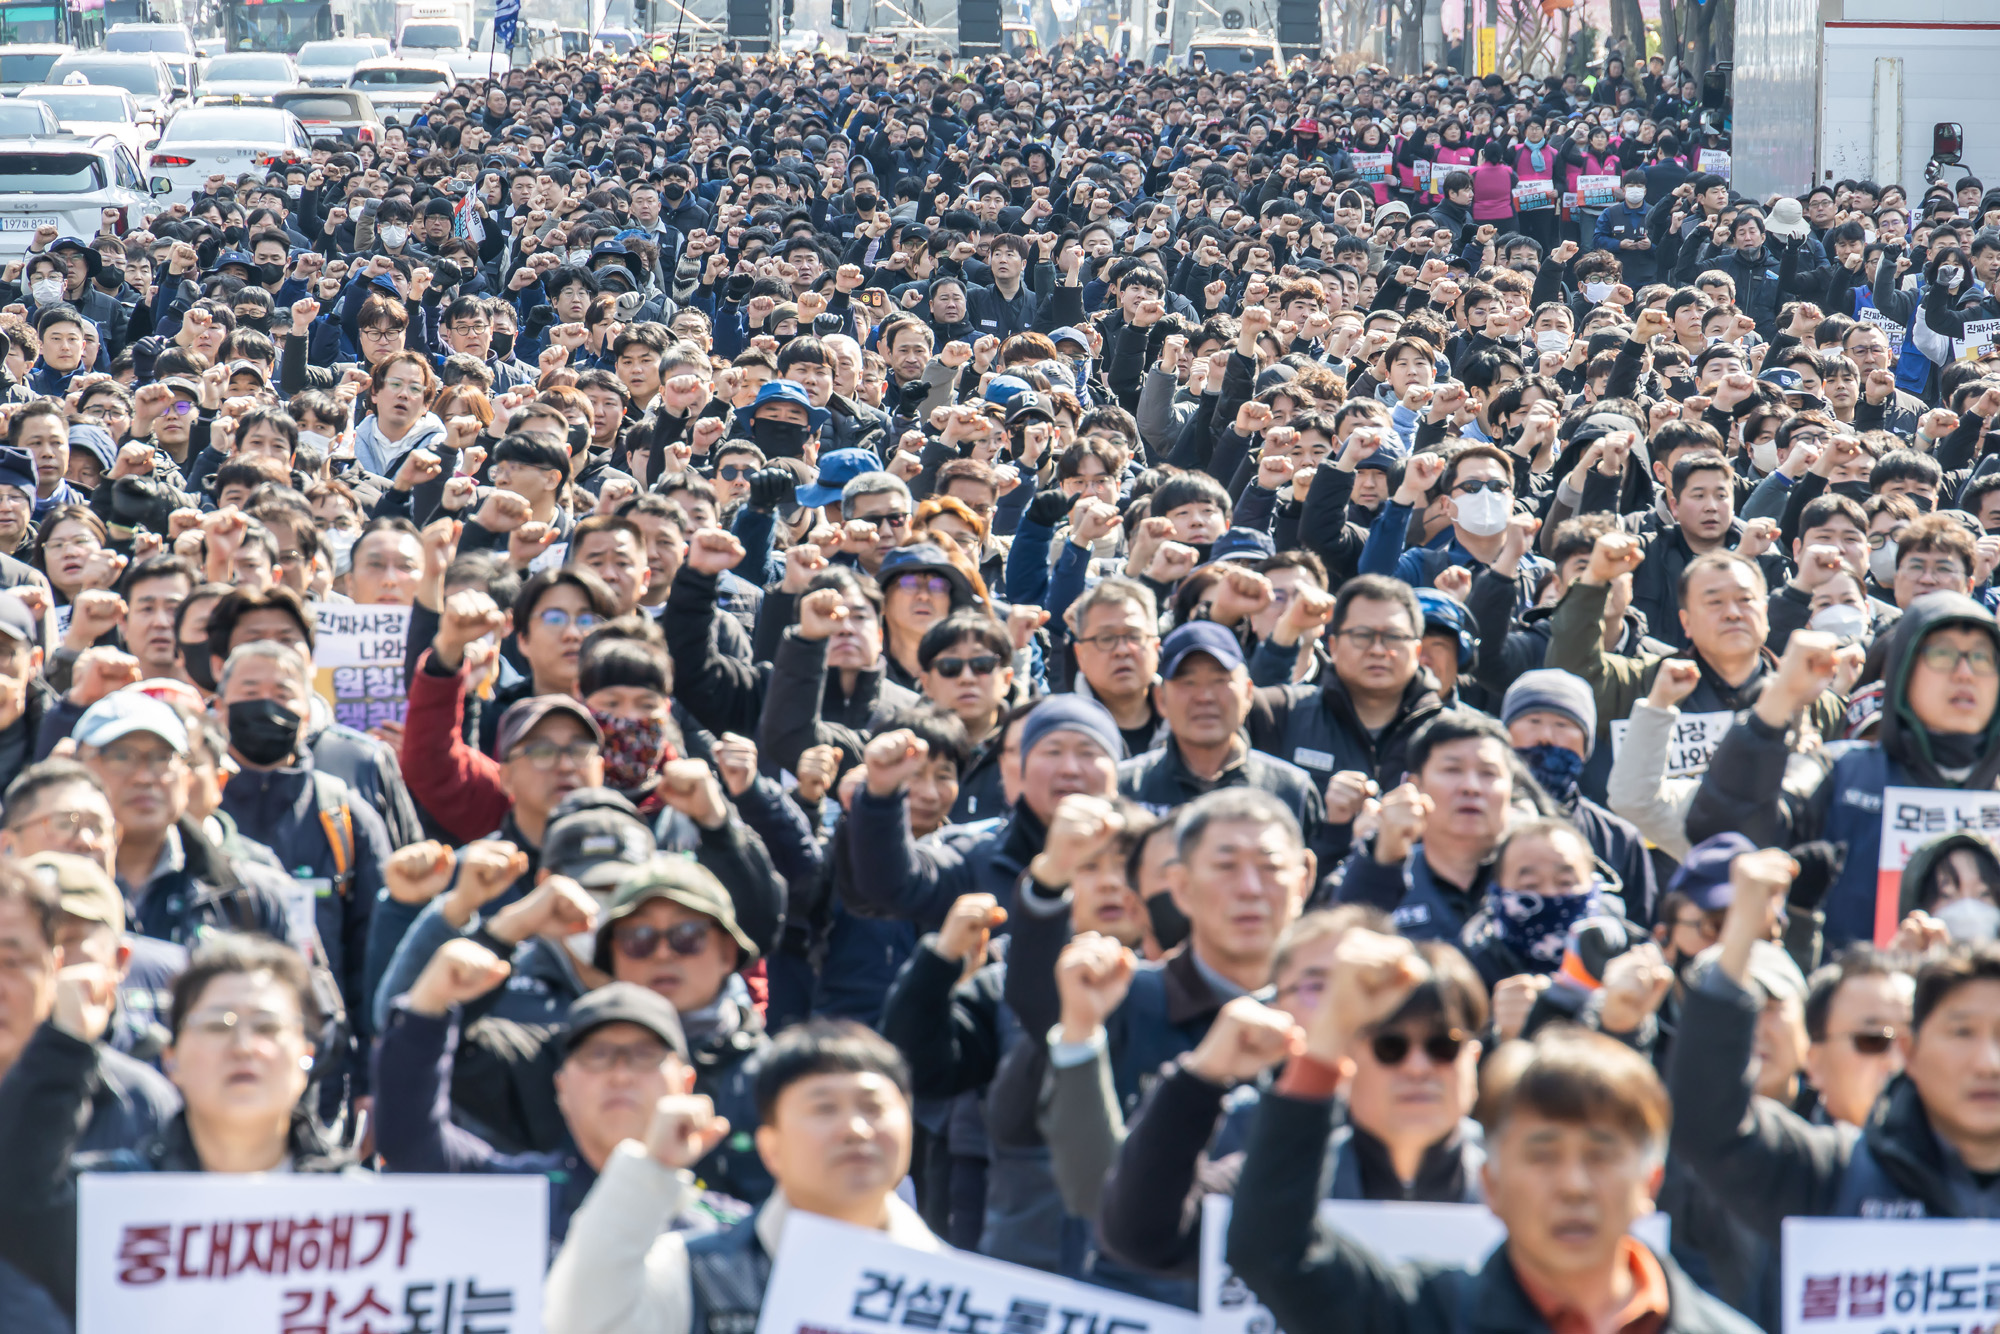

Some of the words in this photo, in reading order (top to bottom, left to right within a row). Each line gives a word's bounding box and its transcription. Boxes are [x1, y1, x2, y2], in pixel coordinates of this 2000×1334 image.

[1863, 310, 1889, 321] 진짜사
[316, 611, 405, 635] 진짜사장
[1893, 803, 1946, 833] 모든
[117, 1208, 417, 1286] 중대재해가
